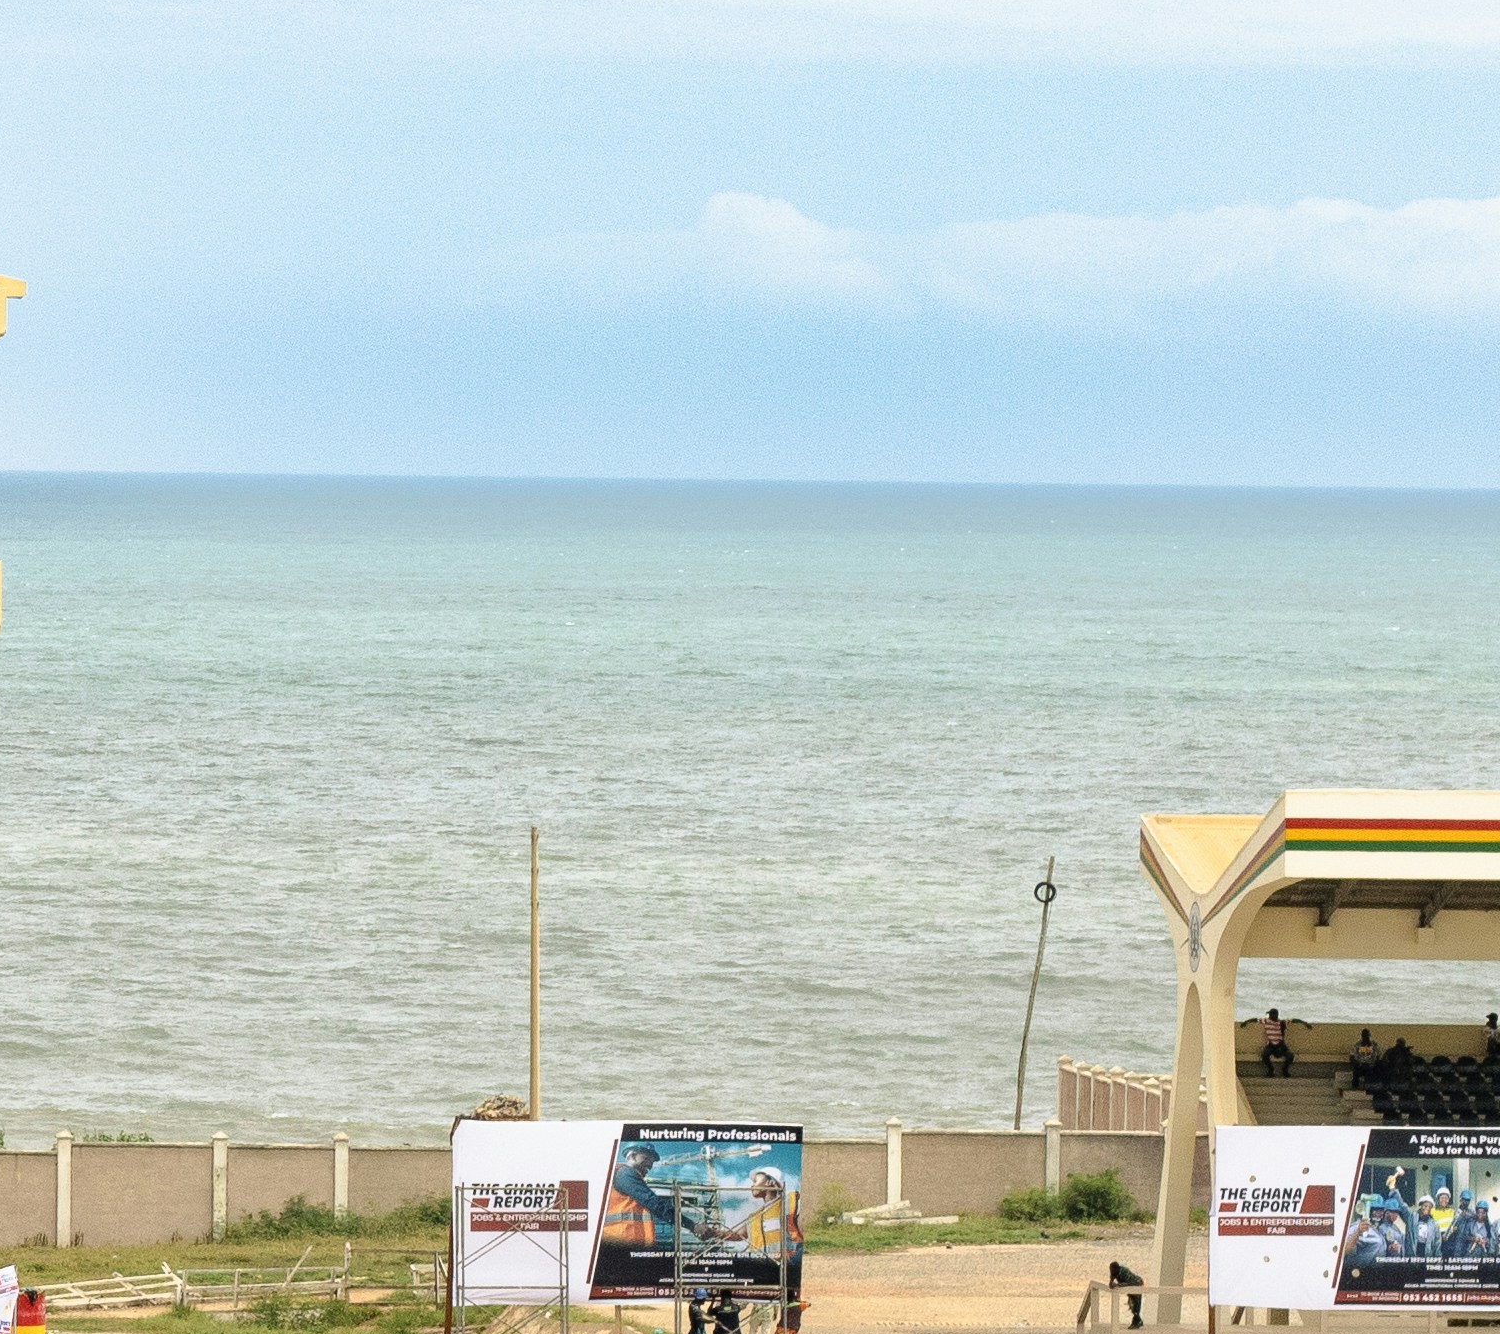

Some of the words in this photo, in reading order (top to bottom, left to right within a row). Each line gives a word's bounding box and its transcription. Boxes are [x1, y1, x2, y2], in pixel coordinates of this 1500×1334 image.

[639, 1128, 705, 1141] Nurturing
[707, 1129, 797, 1142] Professionals
[1409, 1134, 1418, 1144] A
[1420, 1134, 1441, 1144] Fair
[1443, 1134, 1468, 1144] with
[1470, 1136, 1477, 1144] a
[1419, 1146, 1444, 1155] Jobs
[1446, 1146, 1463, 1155] for
[1464, 1146, 1483, 1155] the
[471, 1183, 499, 1196] THE
[1220, 1187, 1247, 1200] THE
[1251, 1187, 1303, 1200] GHANA
[493, 1196, 553, 1208] REPORT
[1241, 1200, 1301, 1213] REPORT
[1220, 1218, 1242, 1226] JOBS
[1250, 1218, 1334, 1226] ENTREPRENEURSHIP
[1267, 1227, 1286, 1235] FAIR
